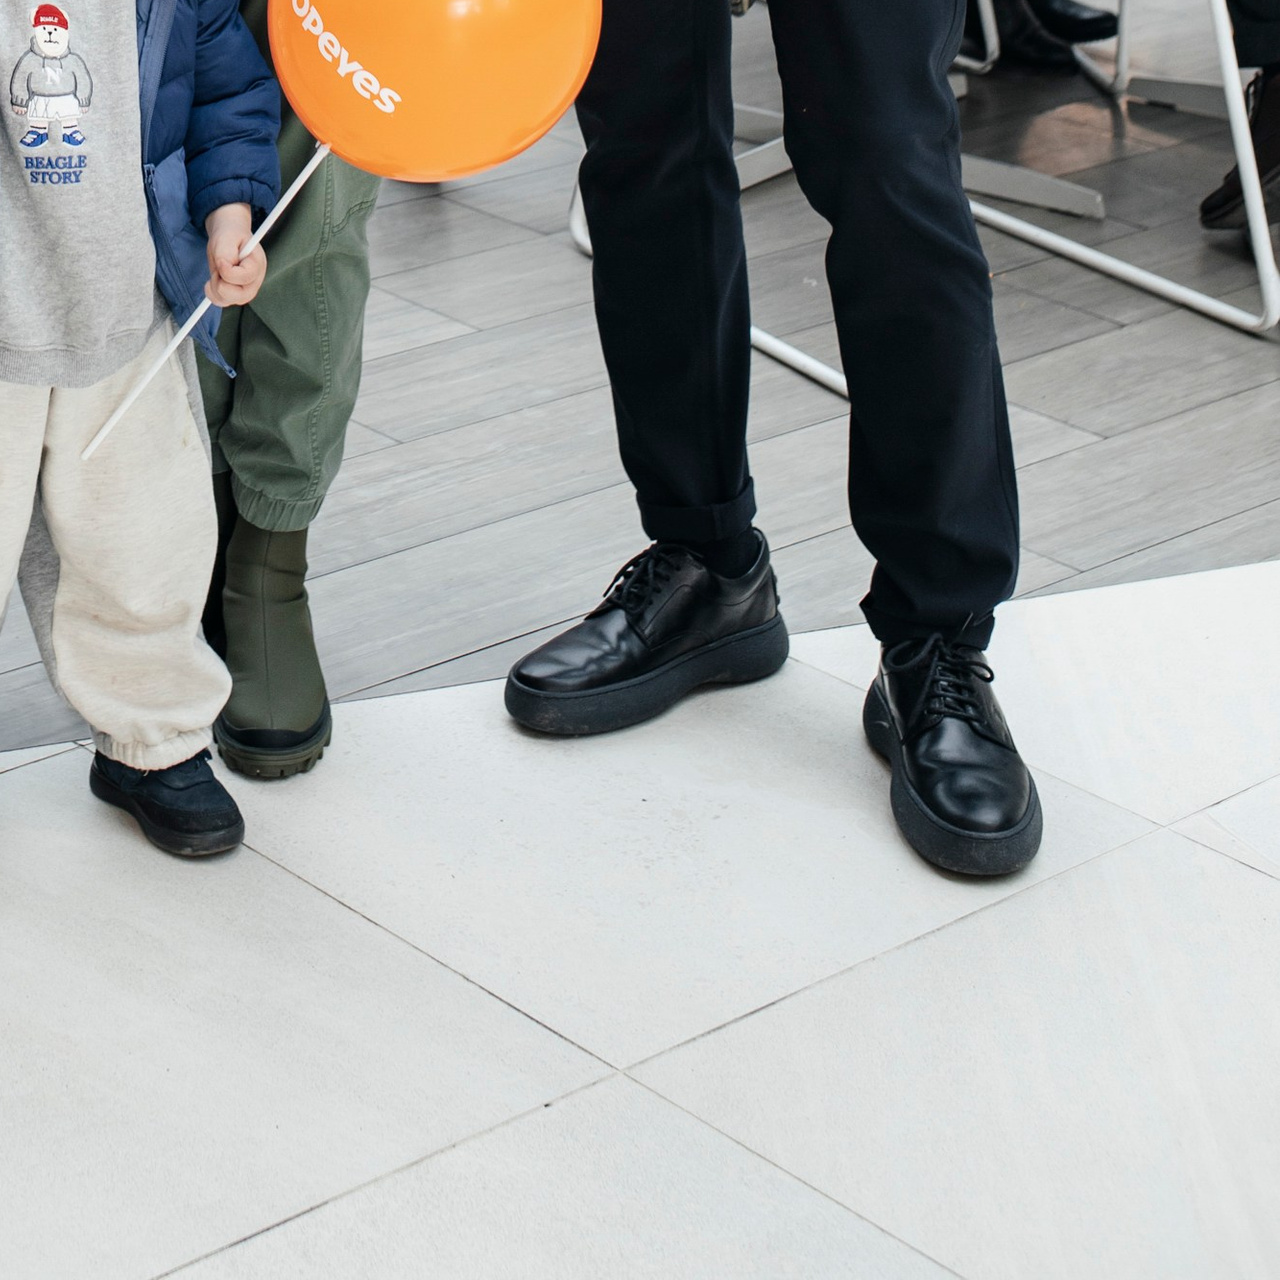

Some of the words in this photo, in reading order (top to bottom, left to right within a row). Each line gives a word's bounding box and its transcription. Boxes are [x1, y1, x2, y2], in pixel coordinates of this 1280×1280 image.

[41, 66, 63, 86] N
[24, 154, 88, 170] BEAGLE
[29, 169, 83, 185] STORY
